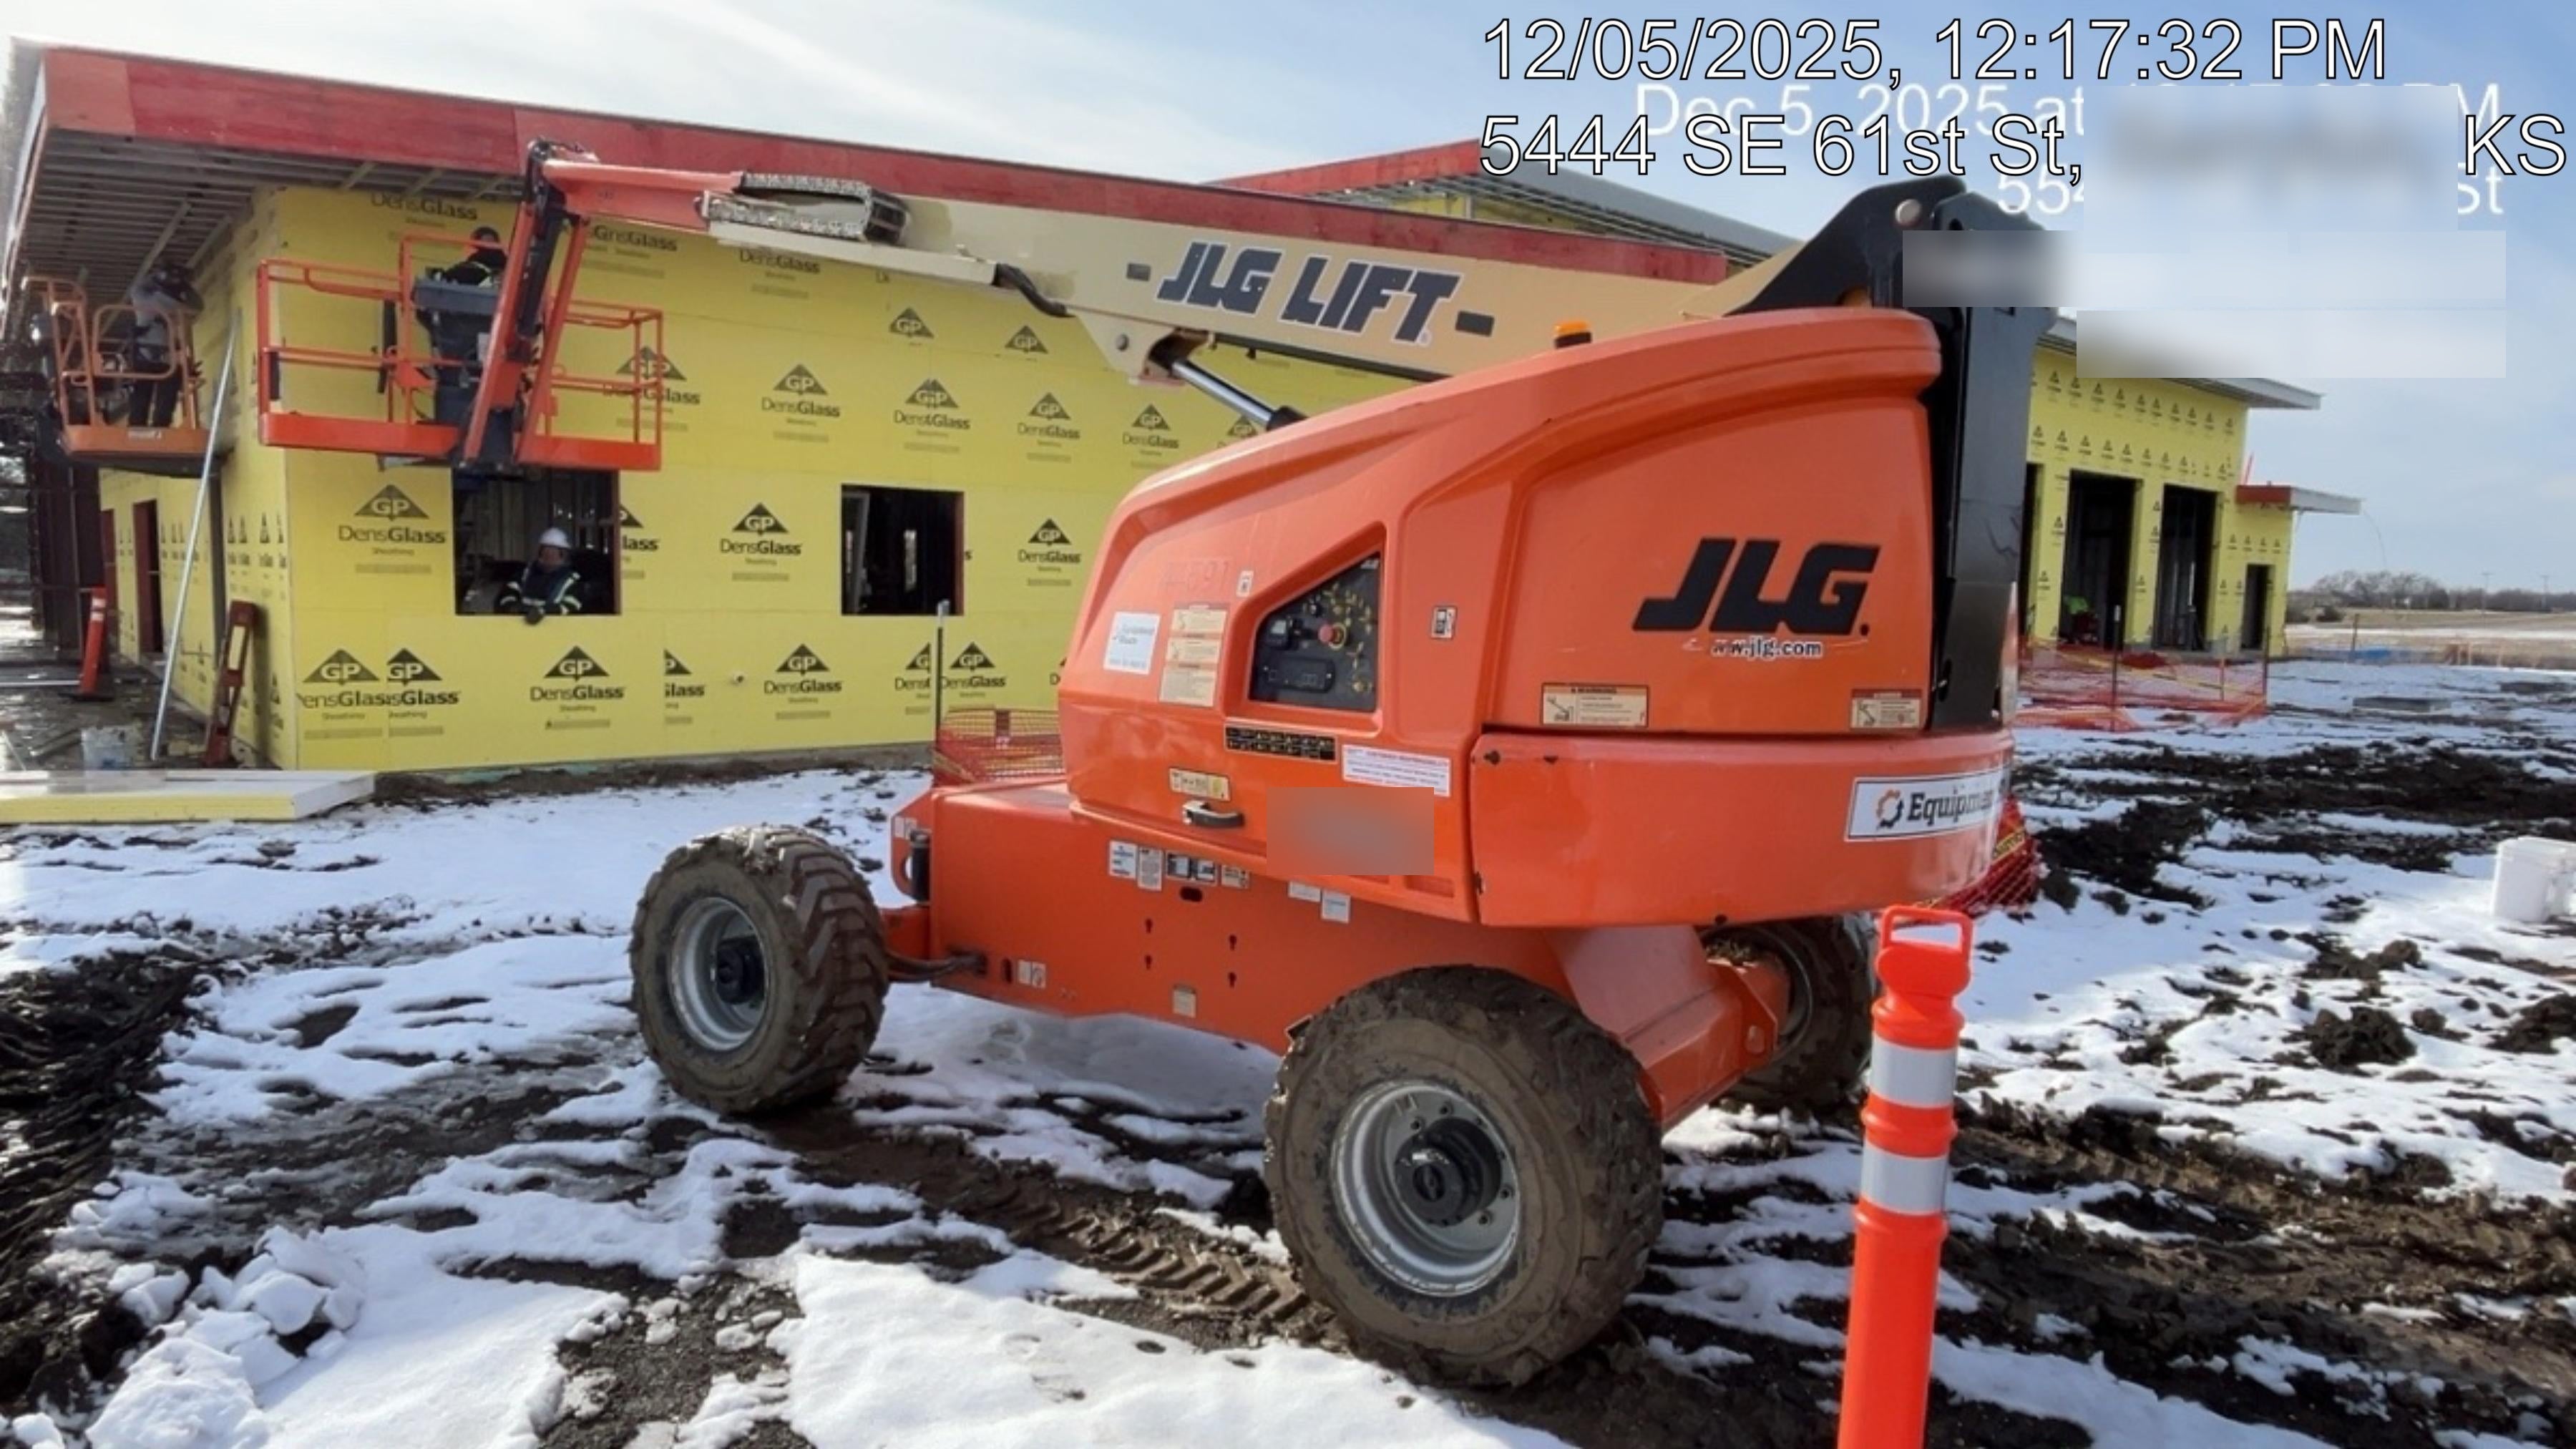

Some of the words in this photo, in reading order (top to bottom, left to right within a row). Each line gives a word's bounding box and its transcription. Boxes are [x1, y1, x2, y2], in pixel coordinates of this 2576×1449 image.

[1156, 240, 1283, 316] JLG
[1279, 255, 1462, 343] LIFT
[786, 375, 816, 392] GP
[371, 497, 411, 516] GP
[744, 515, 775, 532] GP
[338, 524, 447, 545] DensGlass
[719, 538, 803, 555] DensGlass
[1017, 548, 1082, 564] DensGlass
[319, 663, 361, 680] GP
[387, 663, 424, 680] GP
[558, 658, 594, 676] GP
[789, 656, 817, 671] GP
[530, 684, 625, 702] DensGlass
[763, 678, 843, 696] DensGlass
